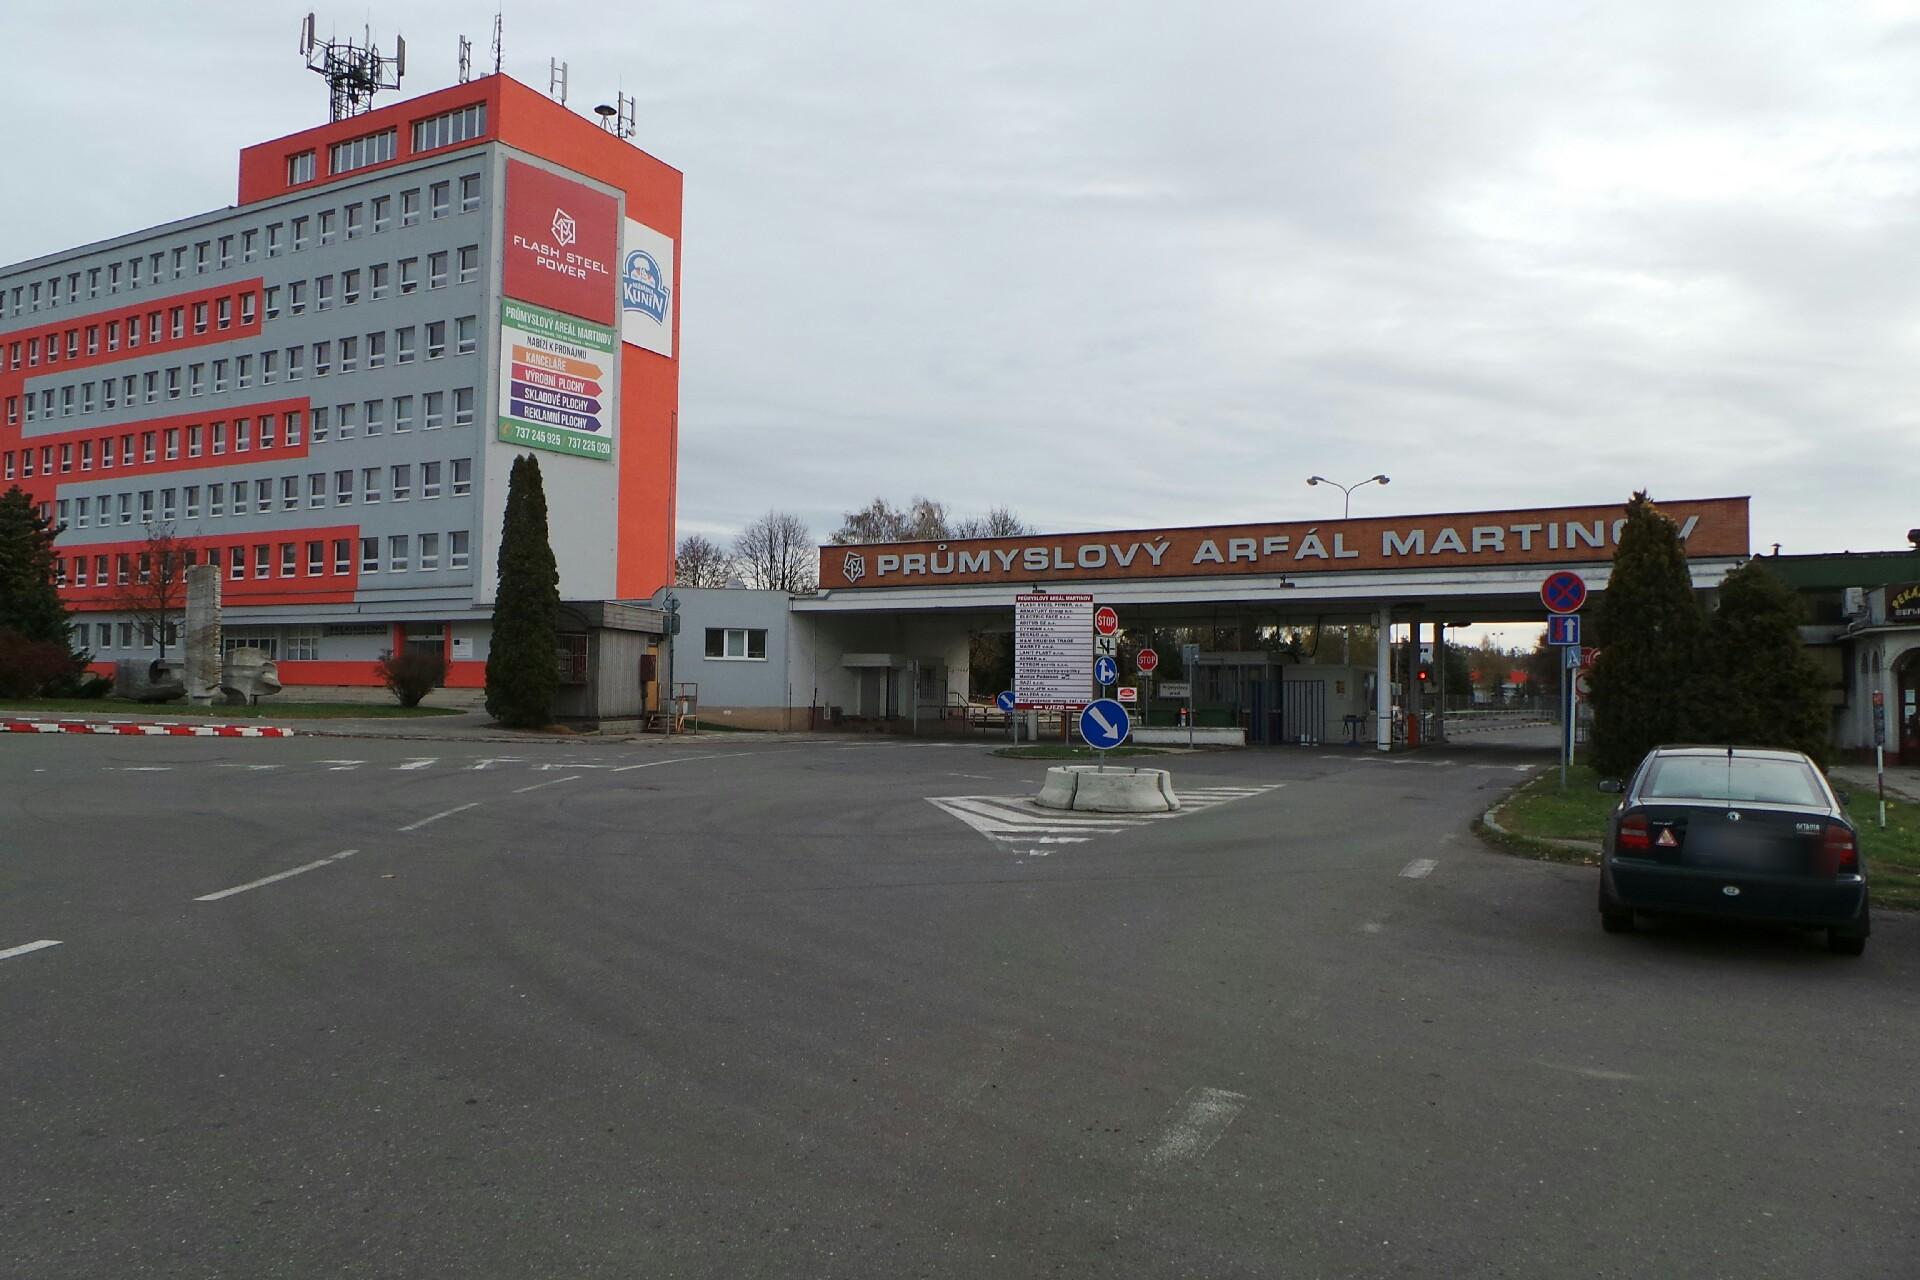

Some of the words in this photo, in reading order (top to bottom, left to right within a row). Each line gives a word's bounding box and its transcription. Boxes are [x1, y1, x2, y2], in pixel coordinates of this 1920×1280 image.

[513, 234, 560, 258] FLASH
[566, 252, 609, 275] STEEL
[536, 256, 586, 280] POWER
[505, 305, 554, 330] PRŮMYSLOVÝ
[554, 319, 577, 337] AREÁL
[577, 327, 612, 345] MARTINOV
[549, 342, 554, 352] K
[525, 369, 556, 387] VÝROBNÍ
[558, 377, 585, 394] PLOCHY
[524, 387, 560, 406] SKLADOVÉ
[562, 396, 588, 412] PLOCHY
[524, 406, 560, 424] REKLAMNÍ
[561, 414, 587, 429] PLOCHY
[515, 426, 529, 438] 737
[546, 433, 561, 446] 925
[568, 436, 581, 449] 737
[596, 441, 610, 454] 020
[877, 535, 1171, 577] PRŮMYSLOVÝ
[1098, 616, 1115, 627] STOP
[1139, 656, 1156, 664] STOP
